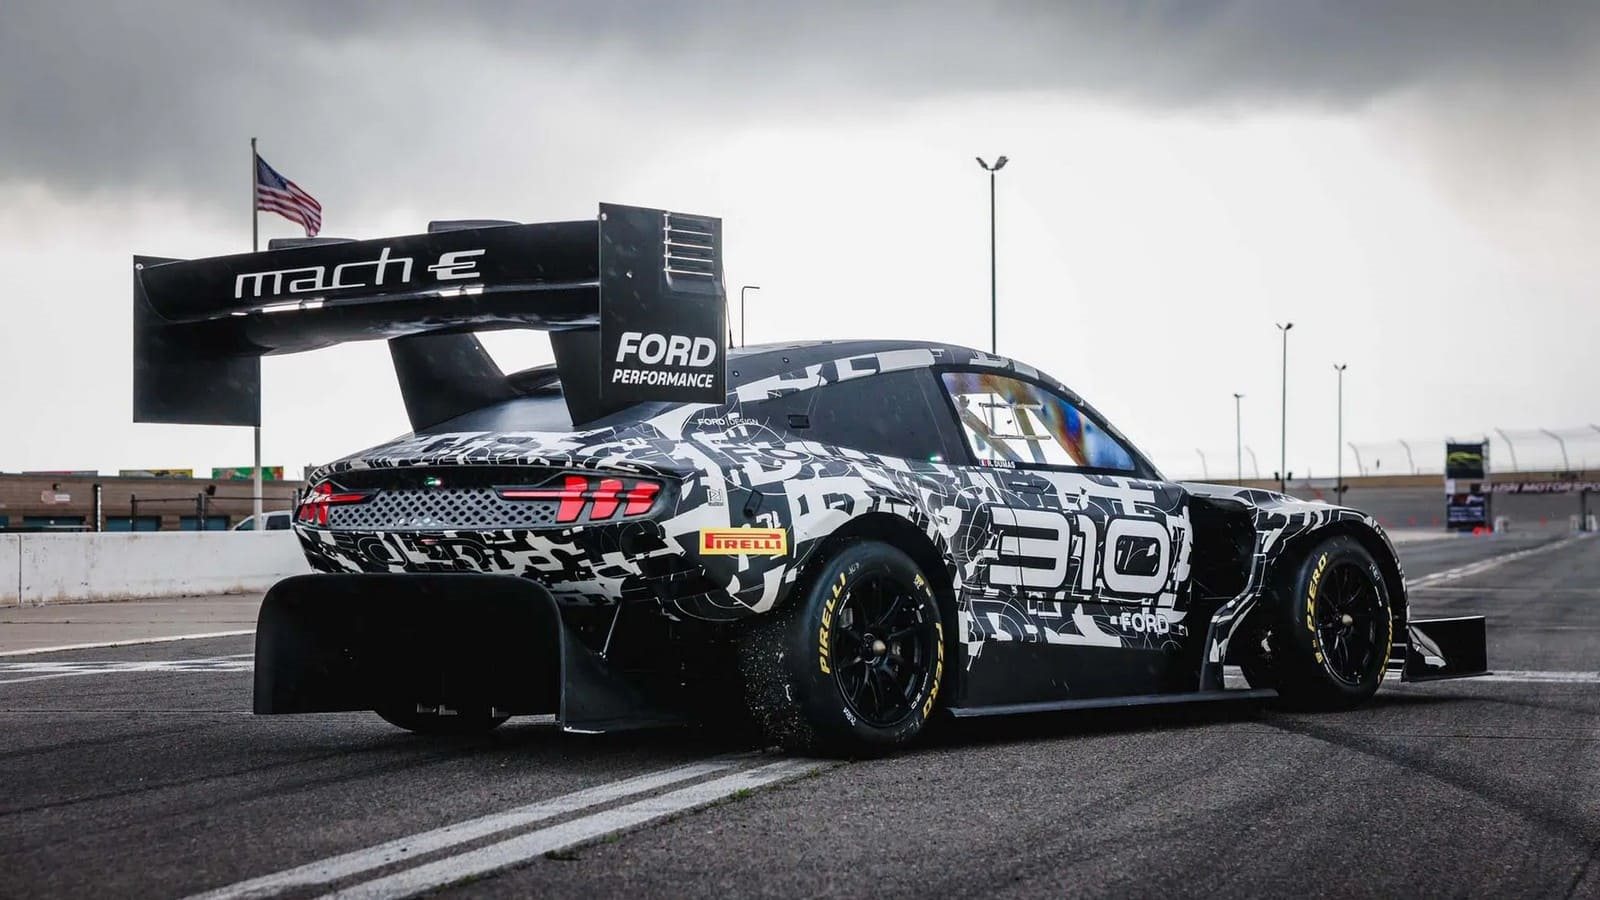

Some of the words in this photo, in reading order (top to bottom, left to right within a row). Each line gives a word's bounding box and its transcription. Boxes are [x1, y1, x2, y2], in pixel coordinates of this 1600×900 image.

[234, 247, 413, 299] mach
[615, 331, 717, 367] FORD
[612, 369, 714, 388] PERFORMANCE
[704, 532, 782, 550] PIRELLI
[989, 506, 1170, 594] 310
[819, 572, 847, 675] PIRELLI
[1119, 611, 1169, 636] FORD
